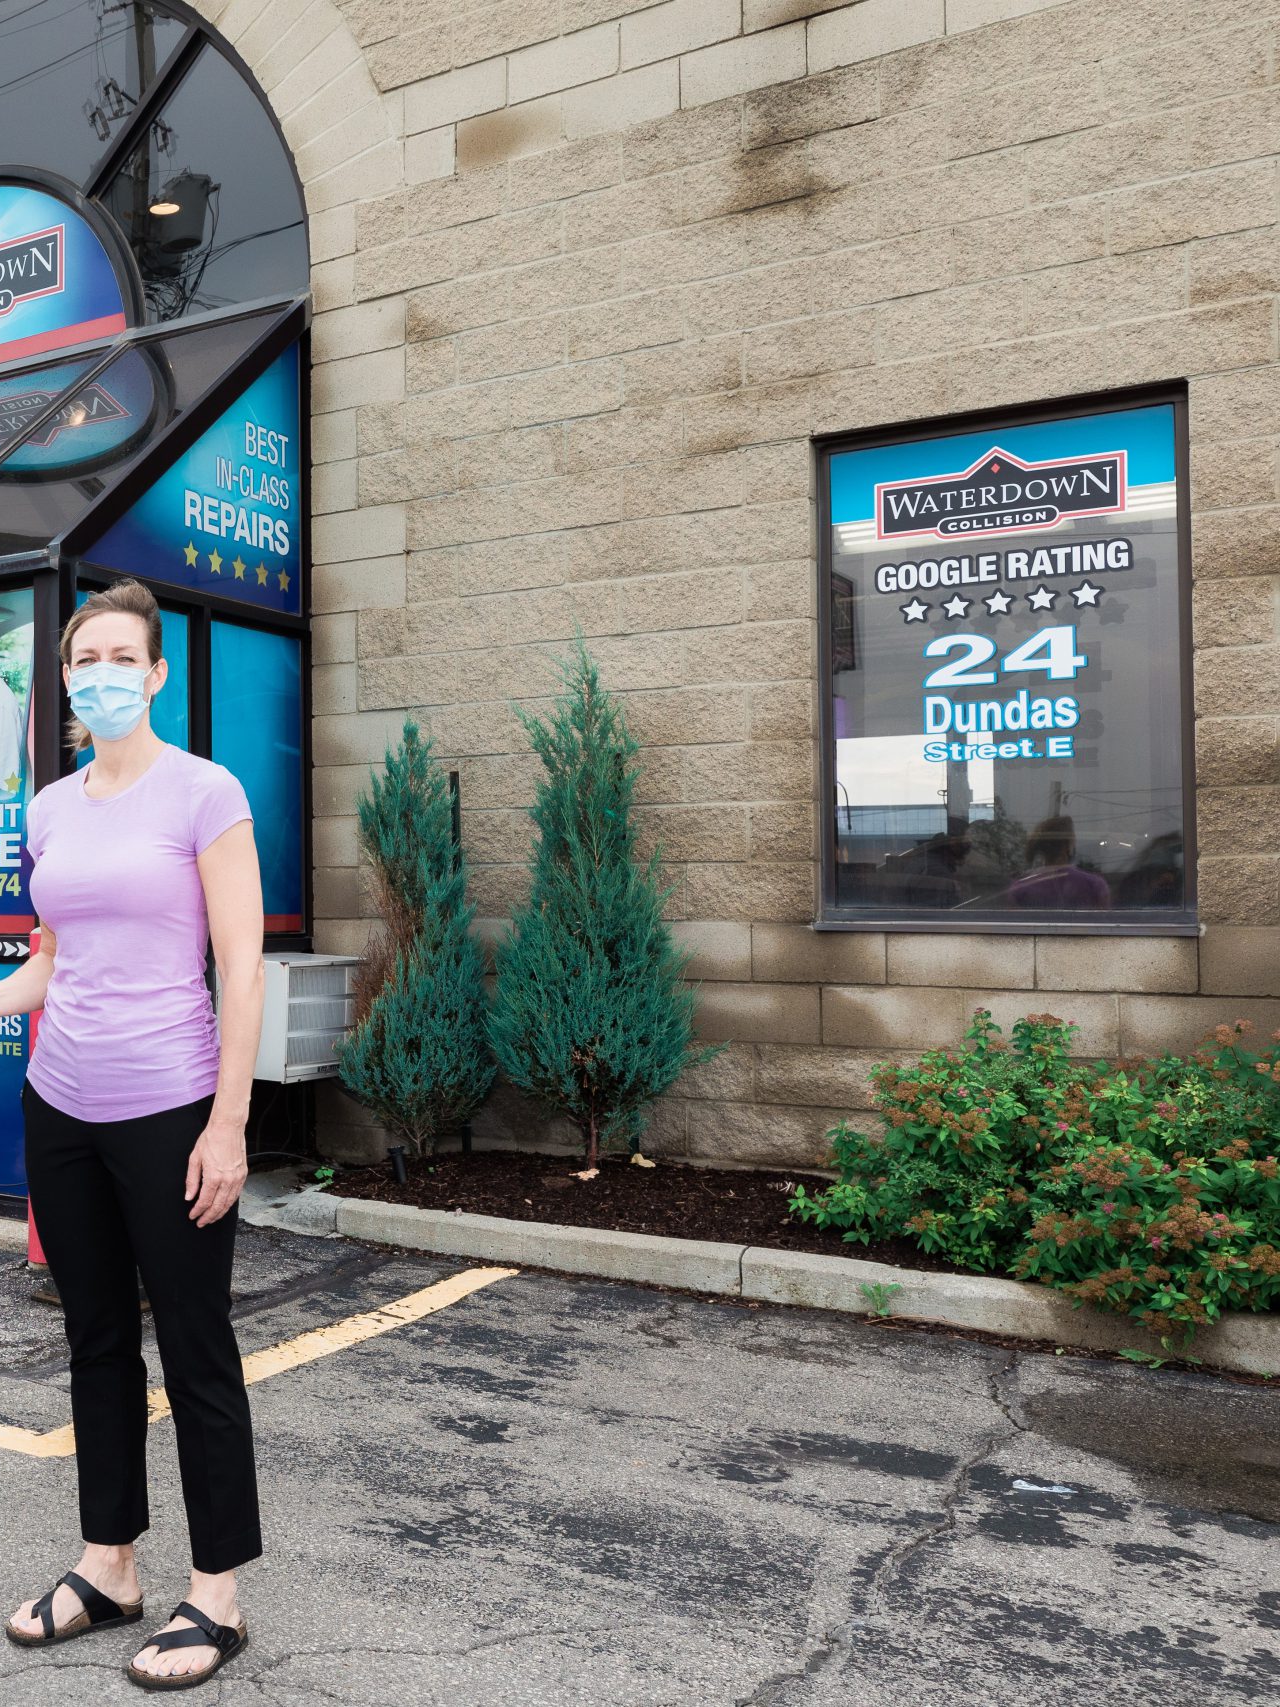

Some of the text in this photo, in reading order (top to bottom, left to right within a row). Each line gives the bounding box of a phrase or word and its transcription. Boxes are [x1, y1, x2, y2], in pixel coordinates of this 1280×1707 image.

[245, 421, 289, 468] BEST
[216, 456, 289, 510] IN-CLASS
[886, 466, 1113, 520] WATERDOWN
[184, 489, 290, 556] REPAIRS
[947, 511, 1047, 532] COLLISION
[876, 539, 1131, 593] GOOGLE RATING
[923, 625, 1088, 688] 24
[923, 689, 1080, 734] Dundas
